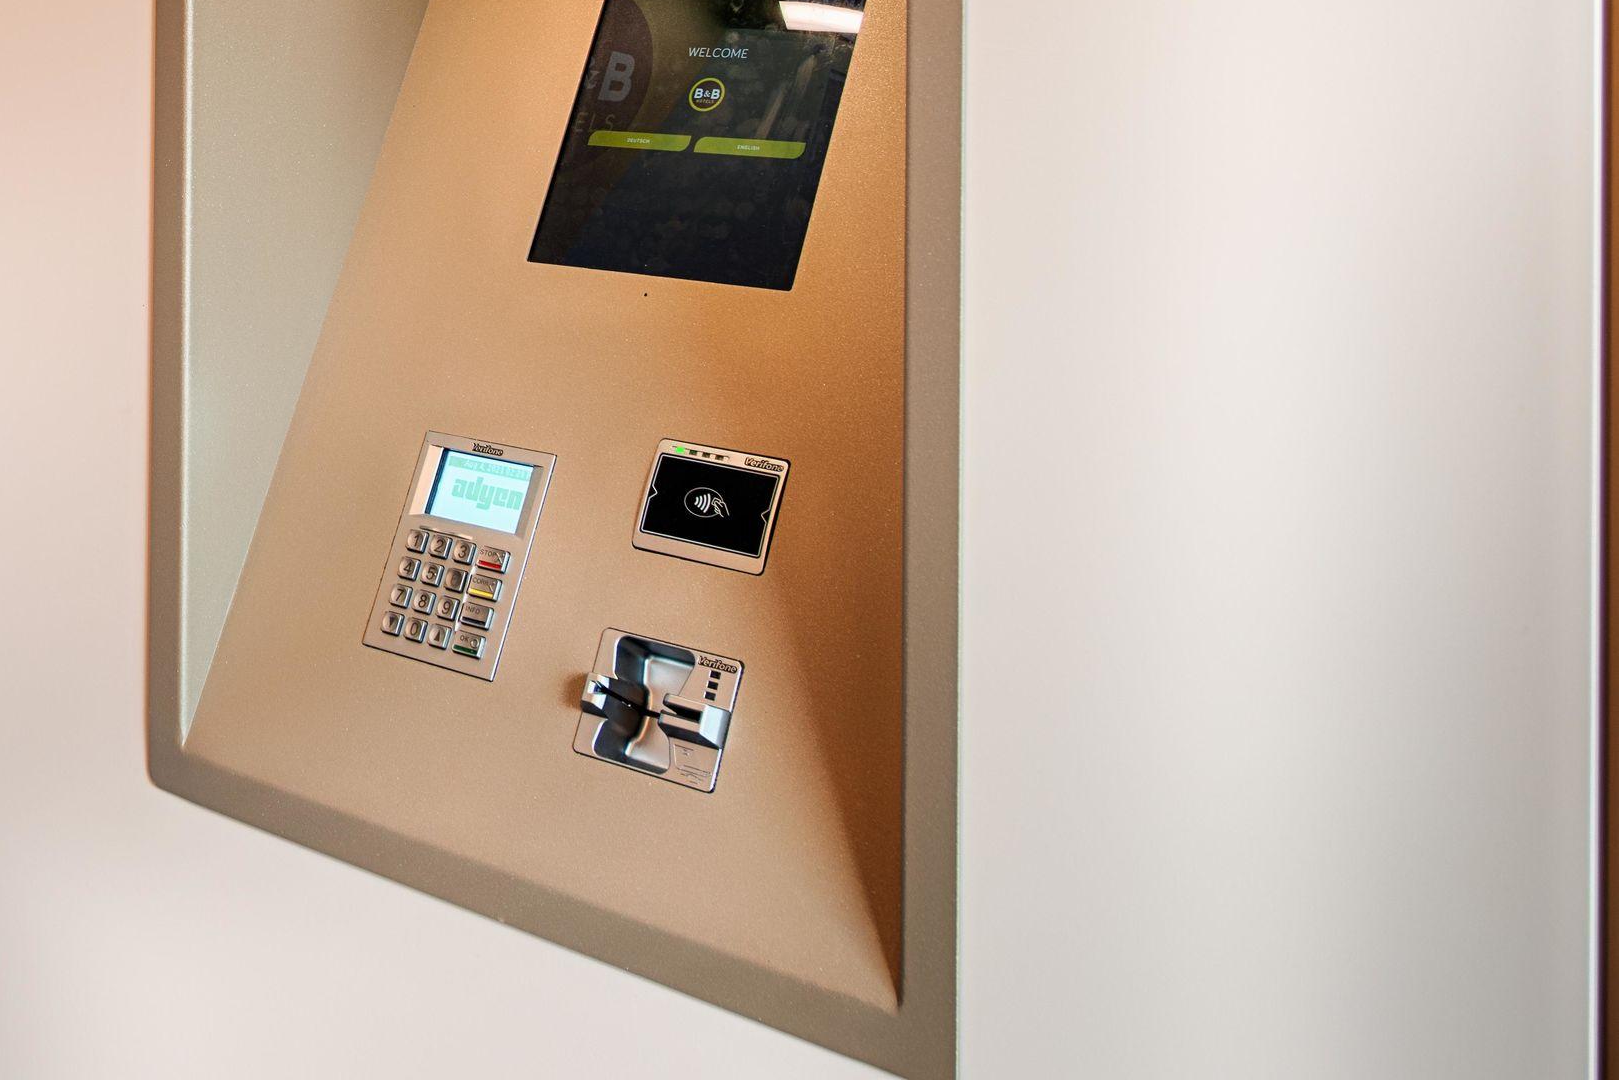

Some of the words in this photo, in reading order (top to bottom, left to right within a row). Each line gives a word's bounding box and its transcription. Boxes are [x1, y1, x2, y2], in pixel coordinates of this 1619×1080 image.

[688, 47, 749, 59] WELCOME
[694, 88, 720, 99] B&B
[471, 442, 504, 456] Verifone
[744, 457, 785, 472] Verifone
[451, 476, 524, 511] adyen
[434, 538, 445, 553] 2
[458, 544, 468, 558] 3
[403, 561, 412, 575] 4
[426, 566, 436, 580] 5
[395, 588, 405, 601] 7
[418, 594, 428, 608] 8
[442, 601, 451, 614] 9
[698, 655, 738, 674] Verifone
